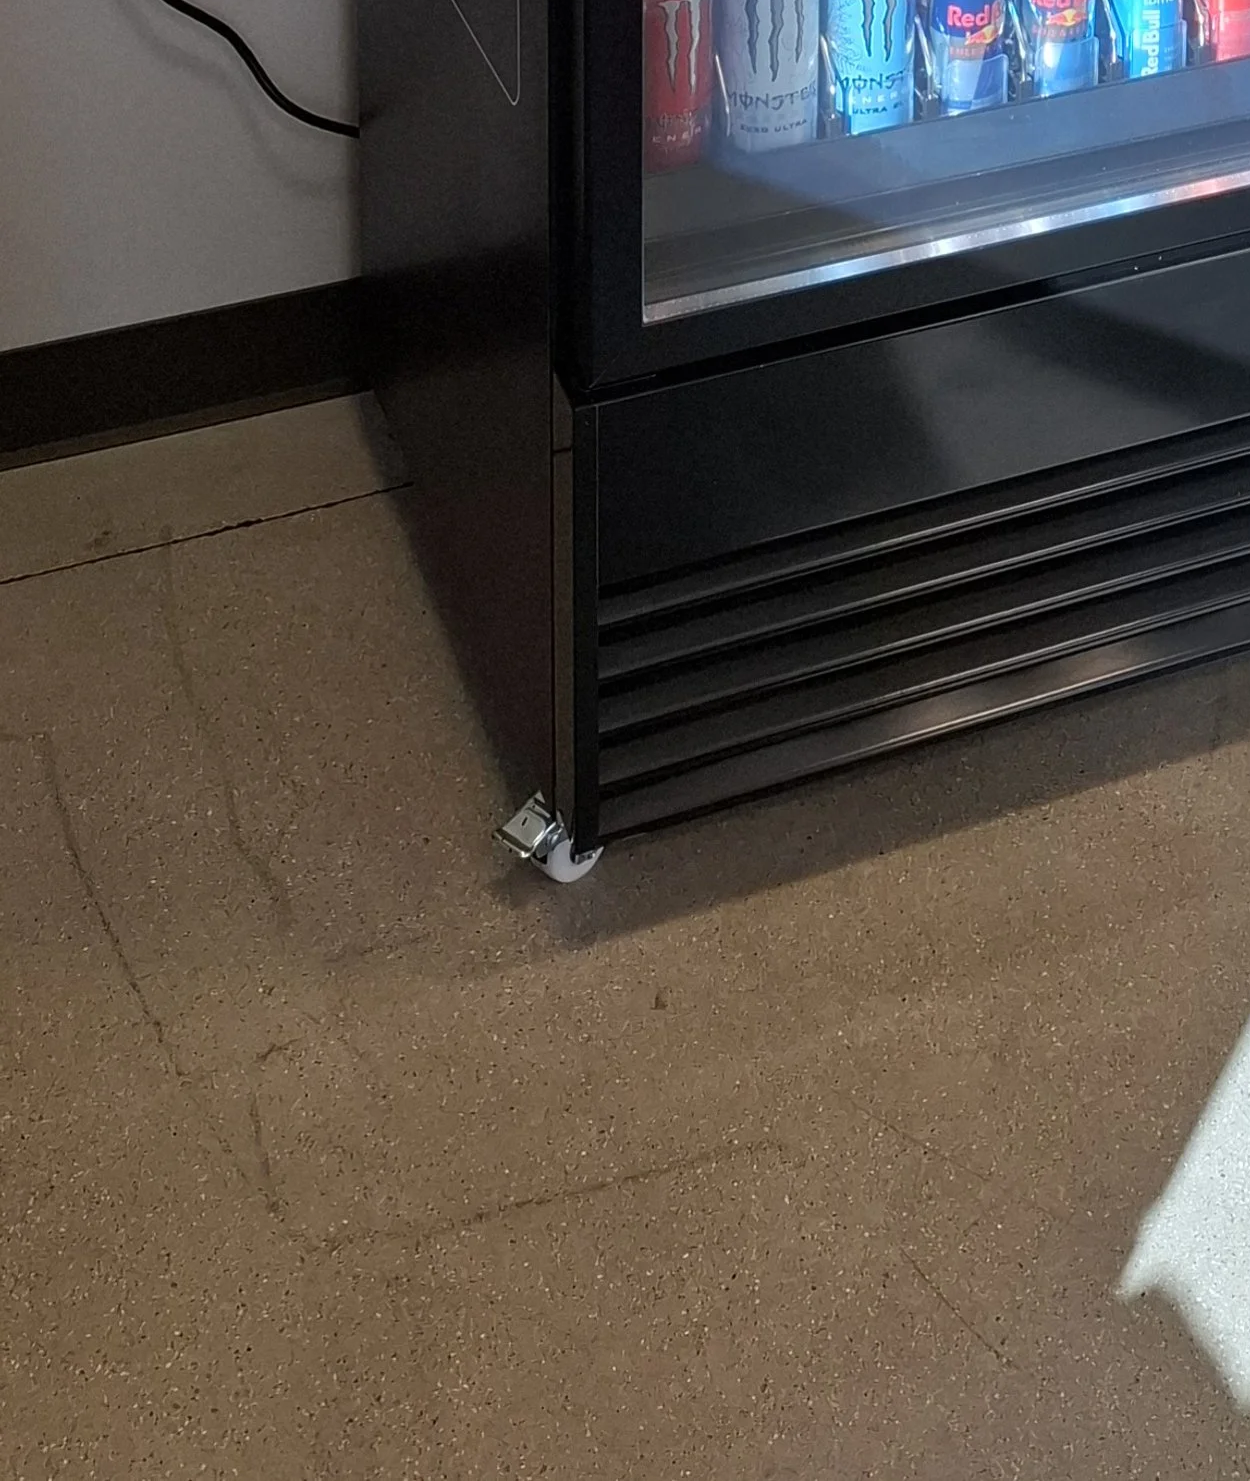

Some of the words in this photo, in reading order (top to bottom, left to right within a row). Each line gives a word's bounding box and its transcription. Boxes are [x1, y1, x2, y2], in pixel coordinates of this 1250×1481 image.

[947, 4, 991, 29] Red
[852, 106, 888, 116] ULTRA
[774, 119, 807, 133] ULTRA
